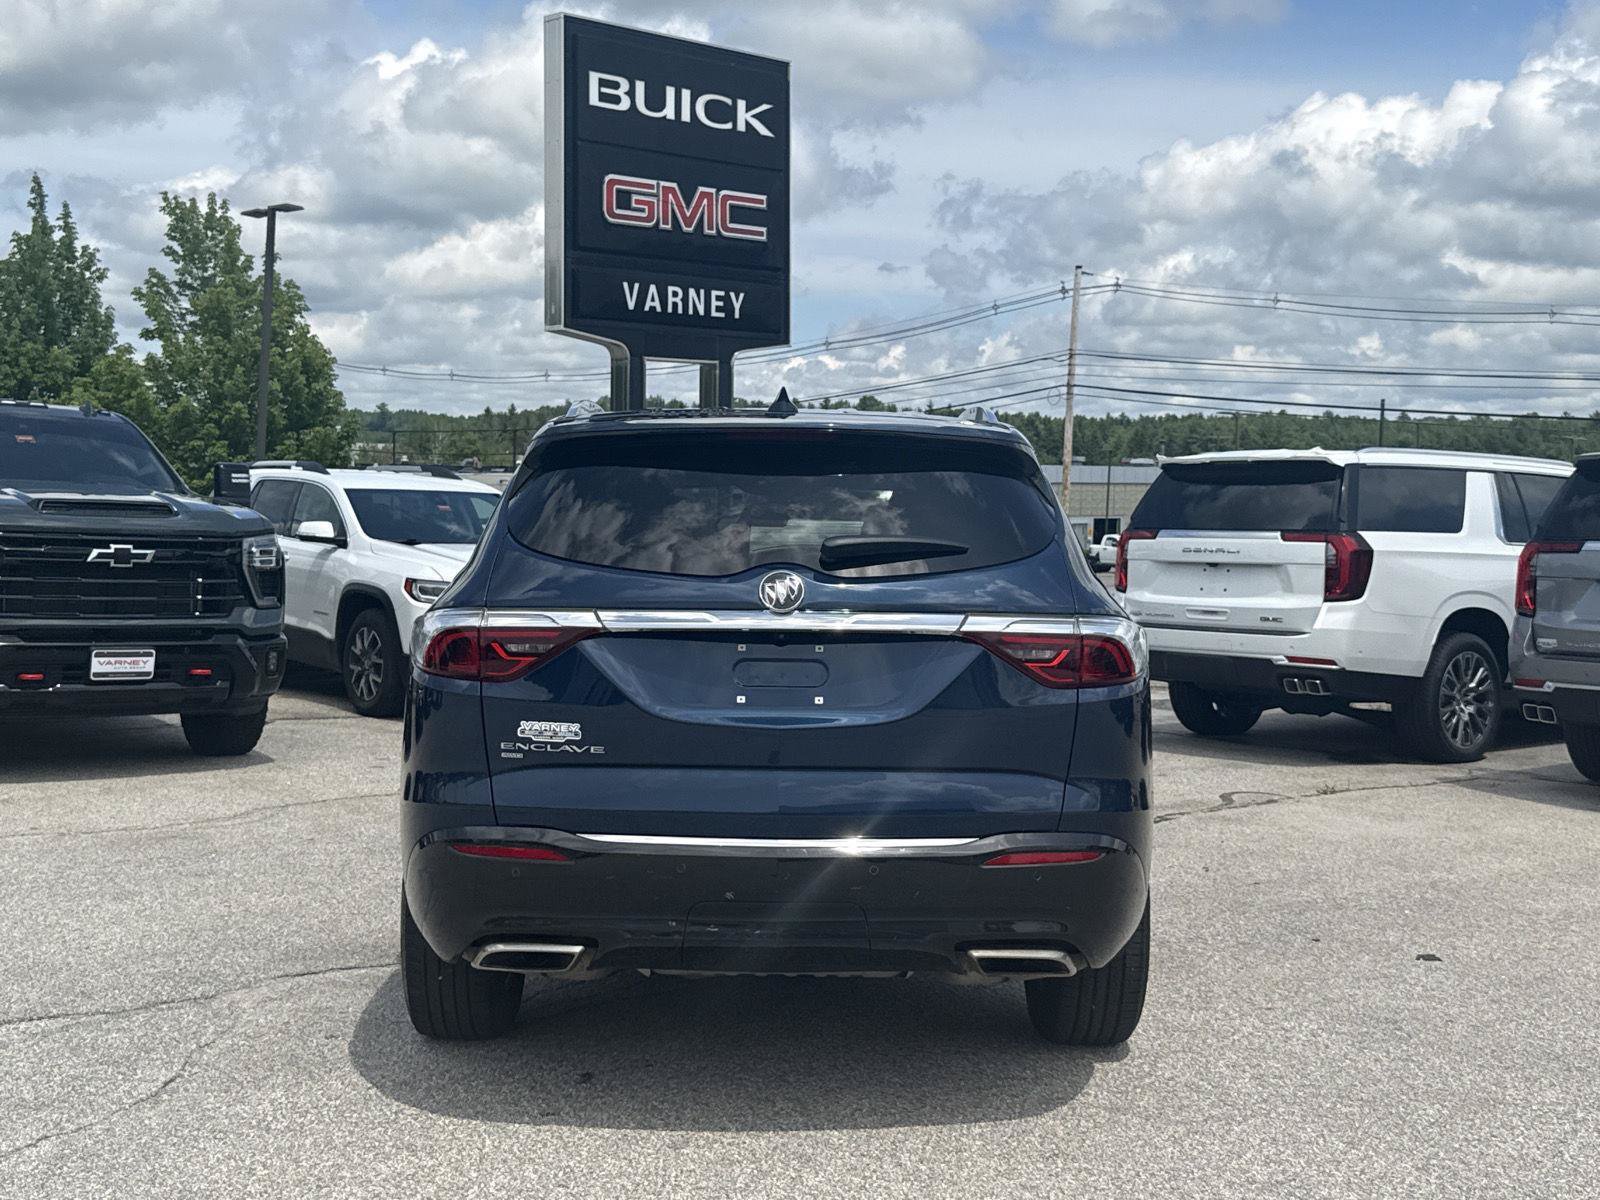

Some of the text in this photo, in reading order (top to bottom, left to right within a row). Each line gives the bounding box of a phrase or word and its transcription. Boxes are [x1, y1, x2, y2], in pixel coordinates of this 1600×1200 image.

[588, 70, 775, 138] BUICK
[602, 173, 767, 242] GMC
[622, 281, 745, 319] VARNEY
[522, 721, 579, 731] VARNEY
[500, 742, 605, 754] ENCLAVE
